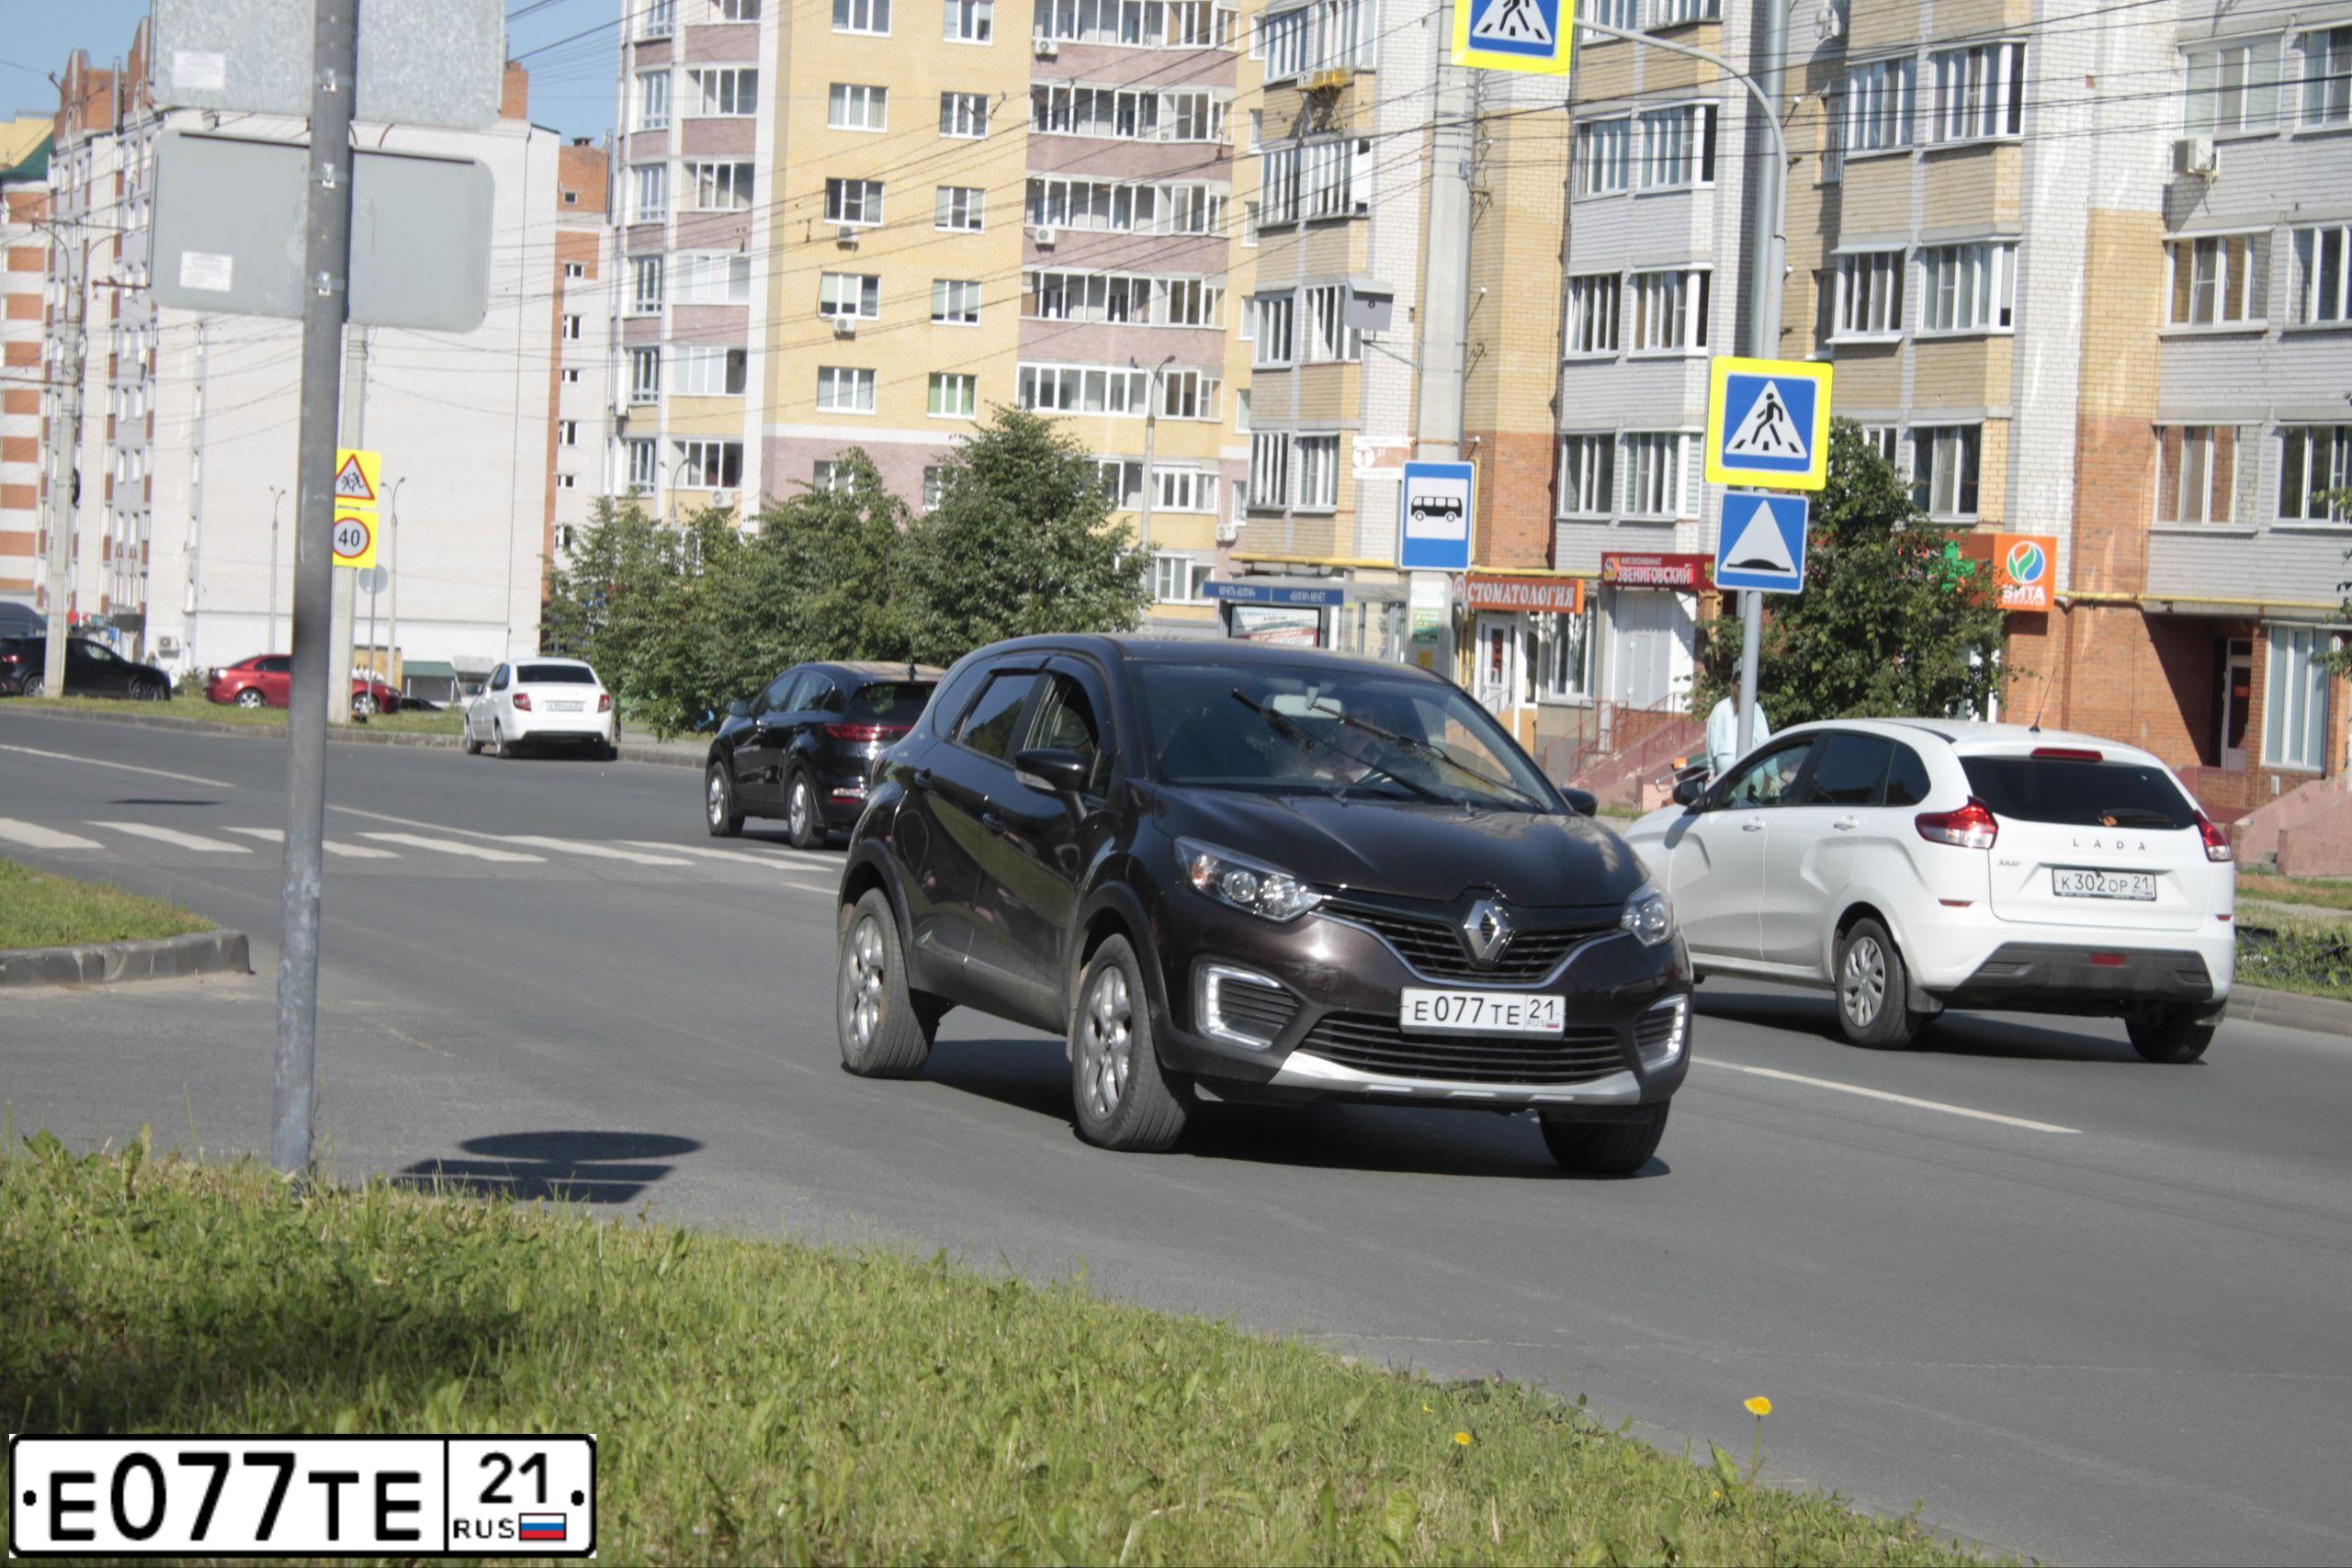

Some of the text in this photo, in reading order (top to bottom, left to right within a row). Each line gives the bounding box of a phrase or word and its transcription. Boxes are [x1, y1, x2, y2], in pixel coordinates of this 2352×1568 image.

[338, 528, 360, 547] 40
[1618, 563, 1692, 584] ЗВЕНИГОВСКИЙ
[1467, 581, 1576, 608] СТОМАТОЛОГИЯ
[2073, 838, 2146, 852] LADA
[2132, 875, 2148, 889] 21
[1529, 998, 1555, 1020] 21
